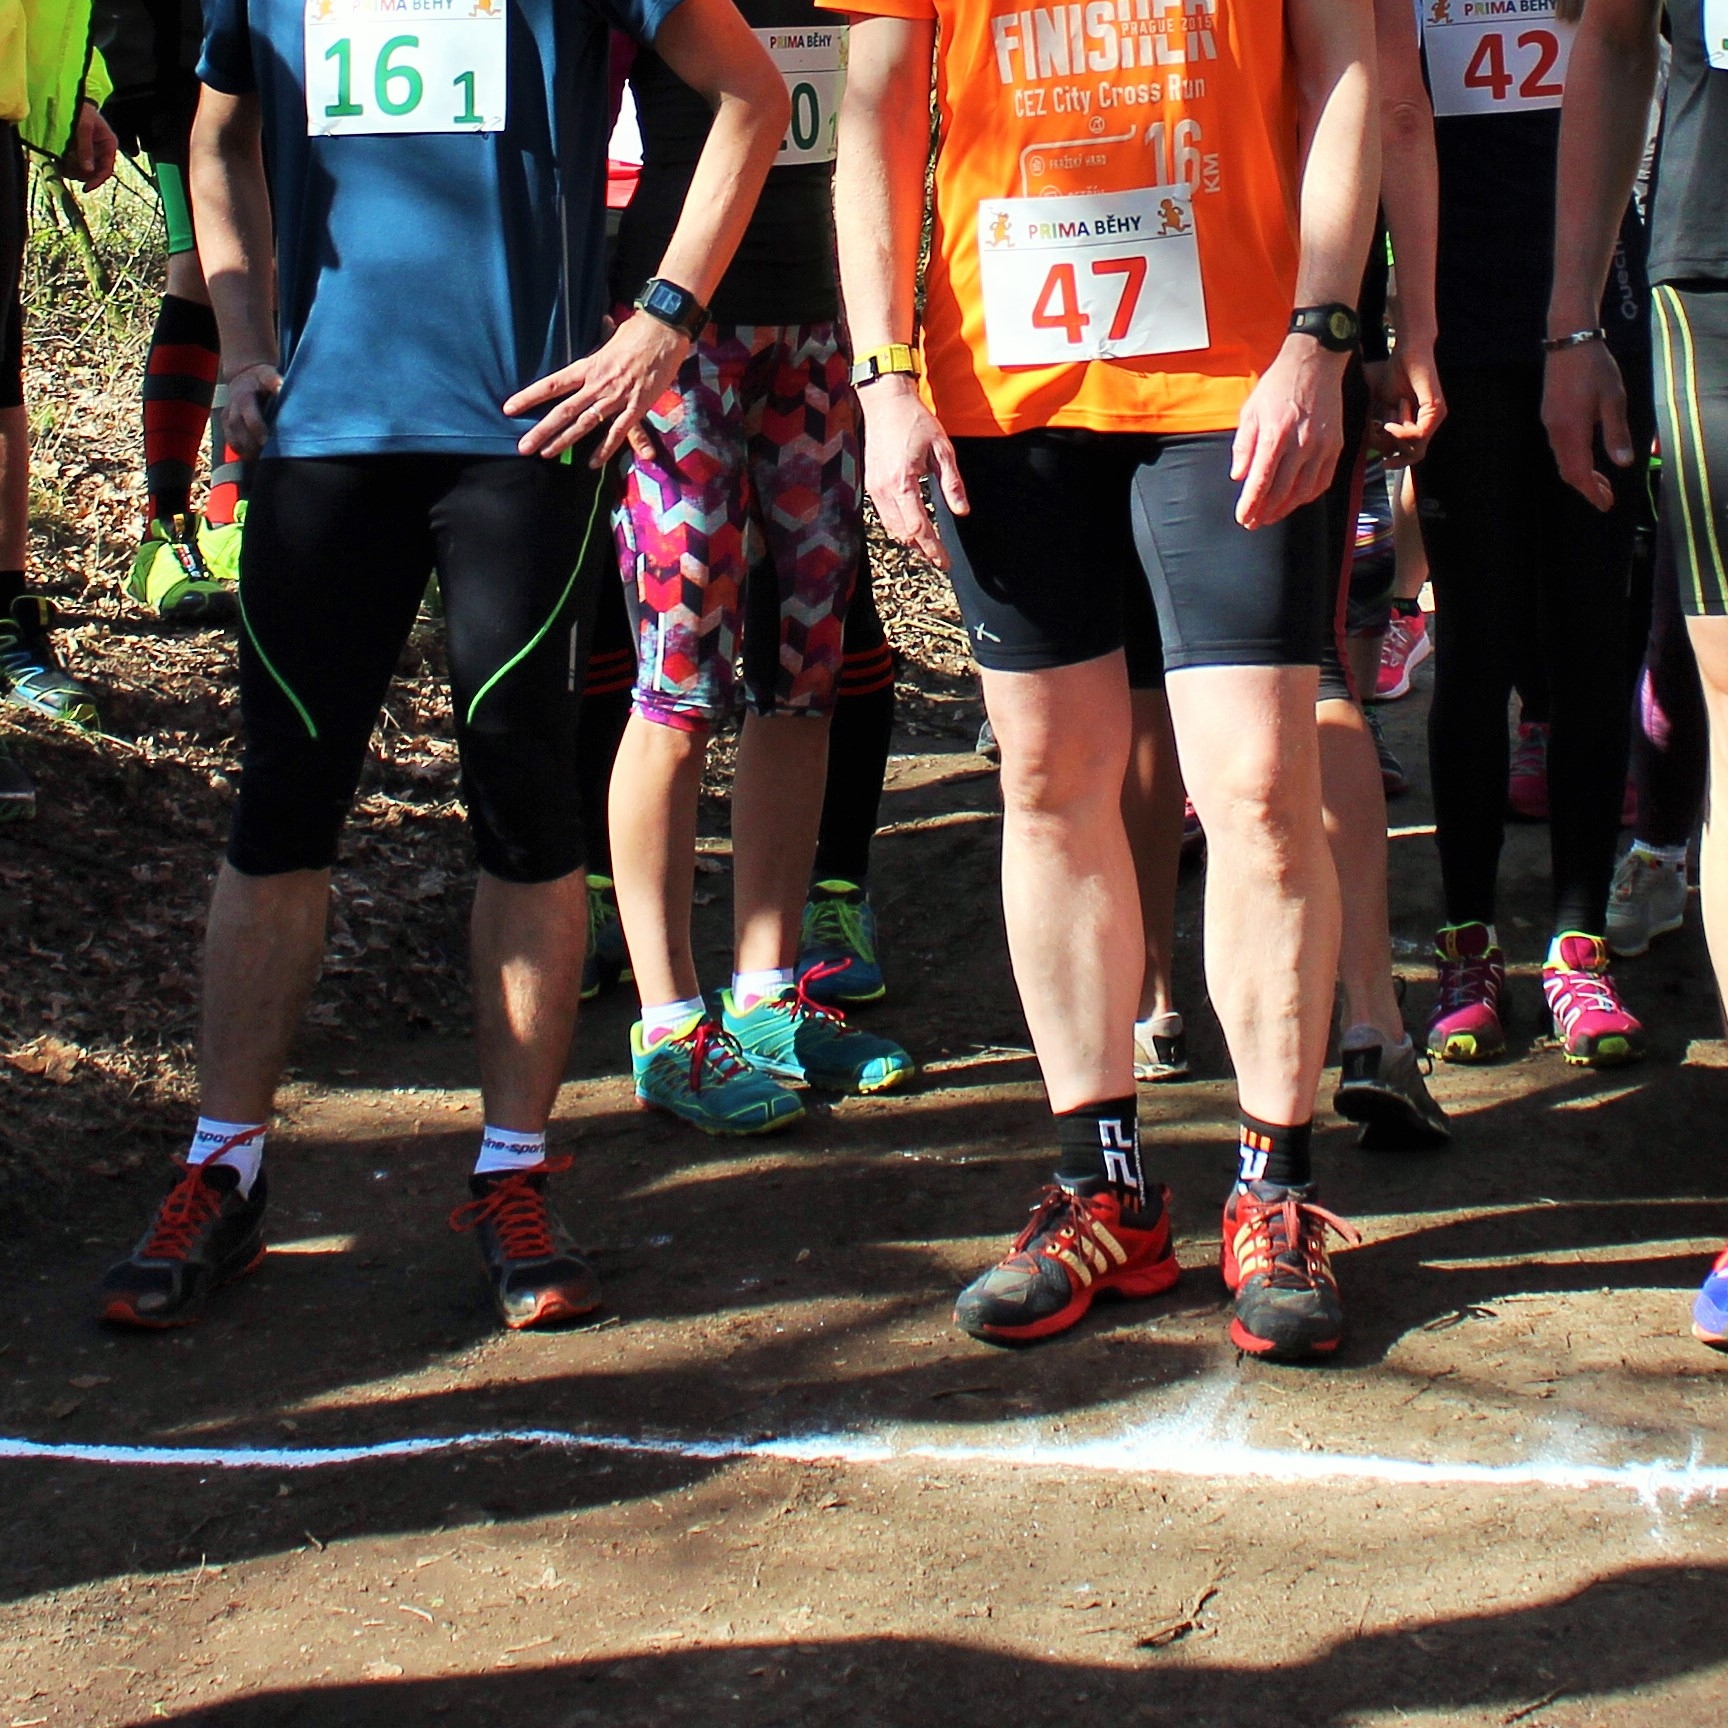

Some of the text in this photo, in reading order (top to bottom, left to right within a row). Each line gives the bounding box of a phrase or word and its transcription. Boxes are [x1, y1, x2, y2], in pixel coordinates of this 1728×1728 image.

[1121, 16, 1213, 36] PRAGUE 2015
[1464, 0, 1517, 17] PRIMA
[770, 32, 833, 49] PRIMA BĚHY
[325, 34, 484, 125] 16 1
[1464, 29, 1564, 100] 42
[779, 82, 820, 151] 0
[1014, 74, 1205, 118] ČEZ City Cross Run
[1144, 118, 1202, 196] 16
[1203, 152, 1221, 194] KM
[1028, 214, 1142, 240] PRIMA BĚHY
[1031, 255, 1148, 344] 47
